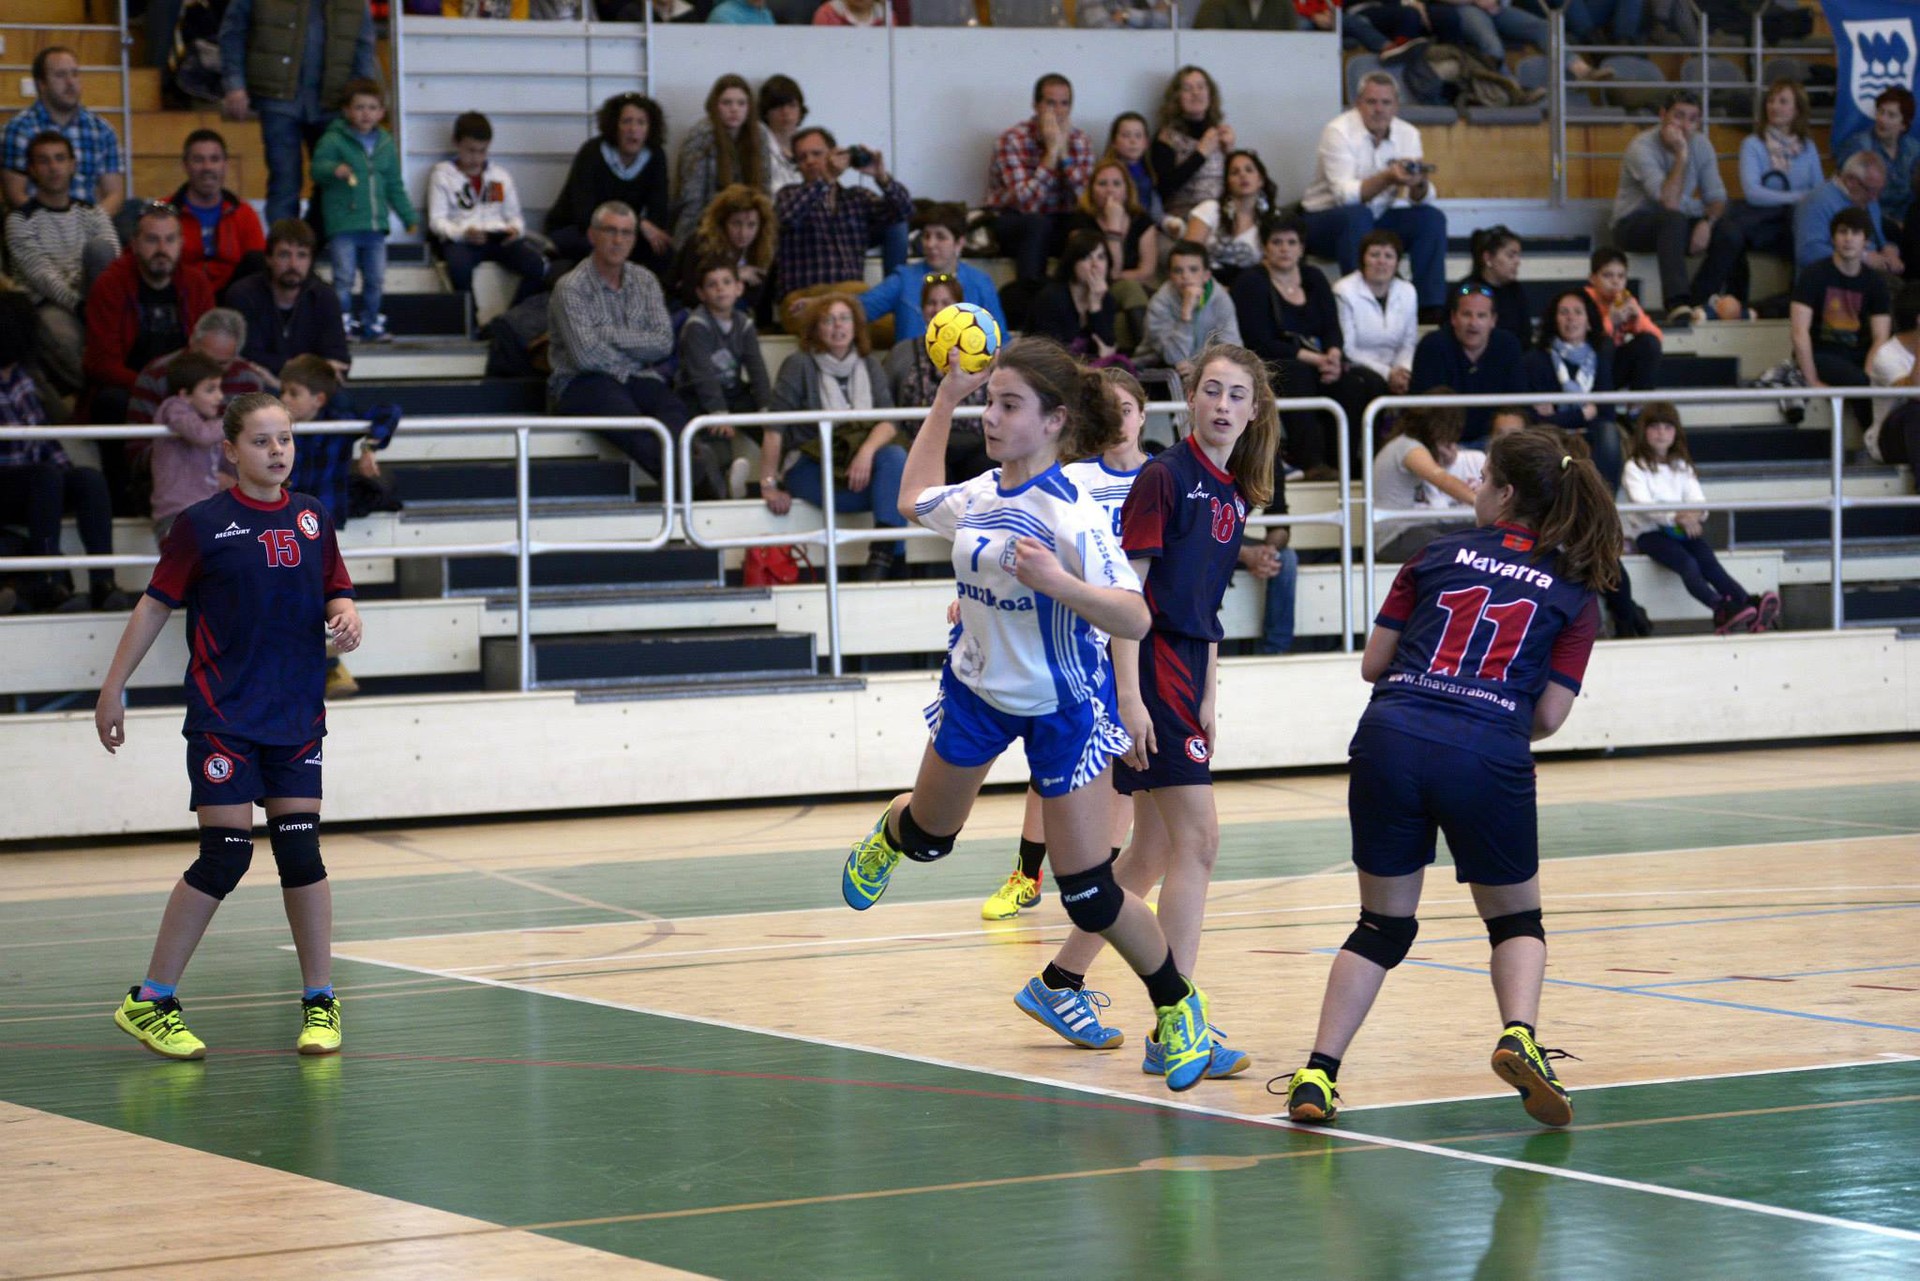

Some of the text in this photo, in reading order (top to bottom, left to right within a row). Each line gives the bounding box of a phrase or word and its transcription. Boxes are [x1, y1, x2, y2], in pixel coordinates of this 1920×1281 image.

[1103, 504, 1123, 537] 8
[1210, 496, 1236, 544] 18
[257, 529, 301, 568] 15
[971, 535, 992, 573] 7
[1455, 548, 1554, 590] Navarra
[1426, 585, 1539, 683] 11
[279, 822, 313, 833] Kempa
[1064, 886, 1099, 903] Kempa
